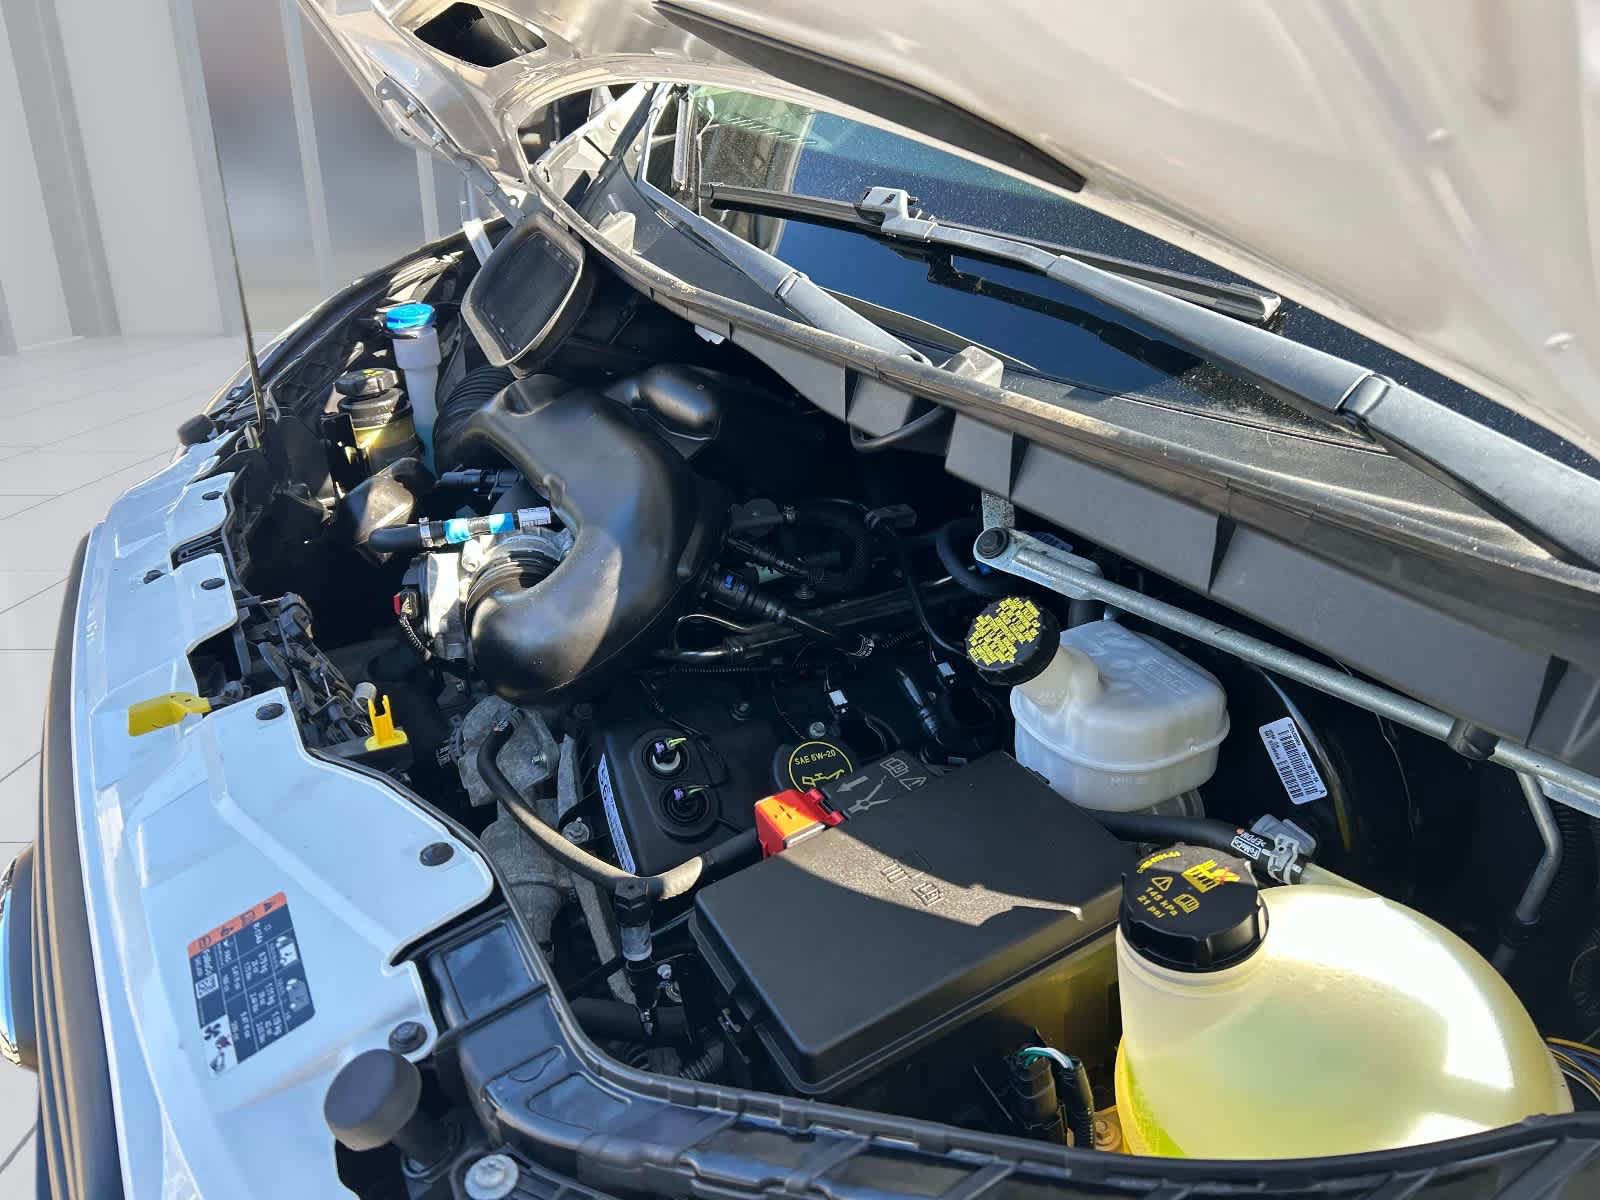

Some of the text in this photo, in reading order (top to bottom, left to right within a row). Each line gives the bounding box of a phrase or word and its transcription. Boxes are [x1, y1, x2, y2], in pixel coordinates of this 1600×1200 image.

[794, 755, 810, 766] SAE
[1137, 895, 1165, 919] 21 psi
[1160, 898, 1178, 917] kPa
